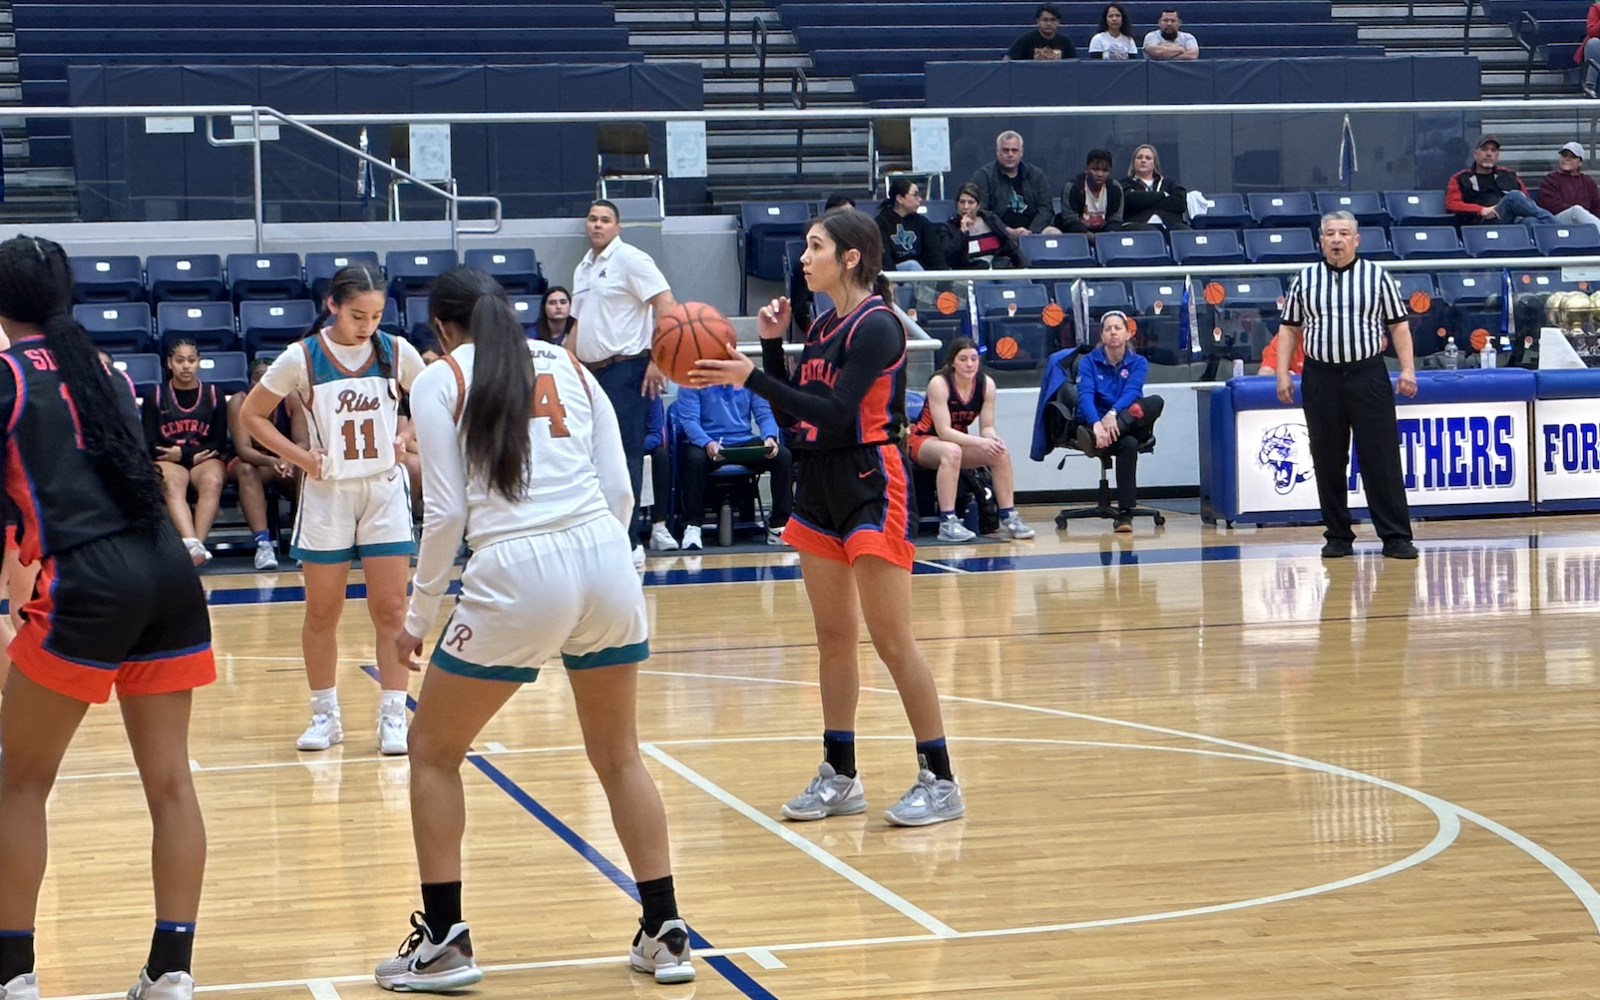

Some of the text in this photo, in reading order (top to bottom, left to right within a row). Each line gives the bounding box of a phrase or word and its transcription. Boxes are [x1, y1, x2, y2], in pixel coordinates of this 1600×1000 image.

[799, 357, 842, 389] ENTRAL
[335, 389, 381, 414] Rise
[161, 418, 211, 438] CENTRAL
[341, 418, 379, 460] 11
[1347, 415, 1516, 492] THERS
[446, 623, 473, 652] R
